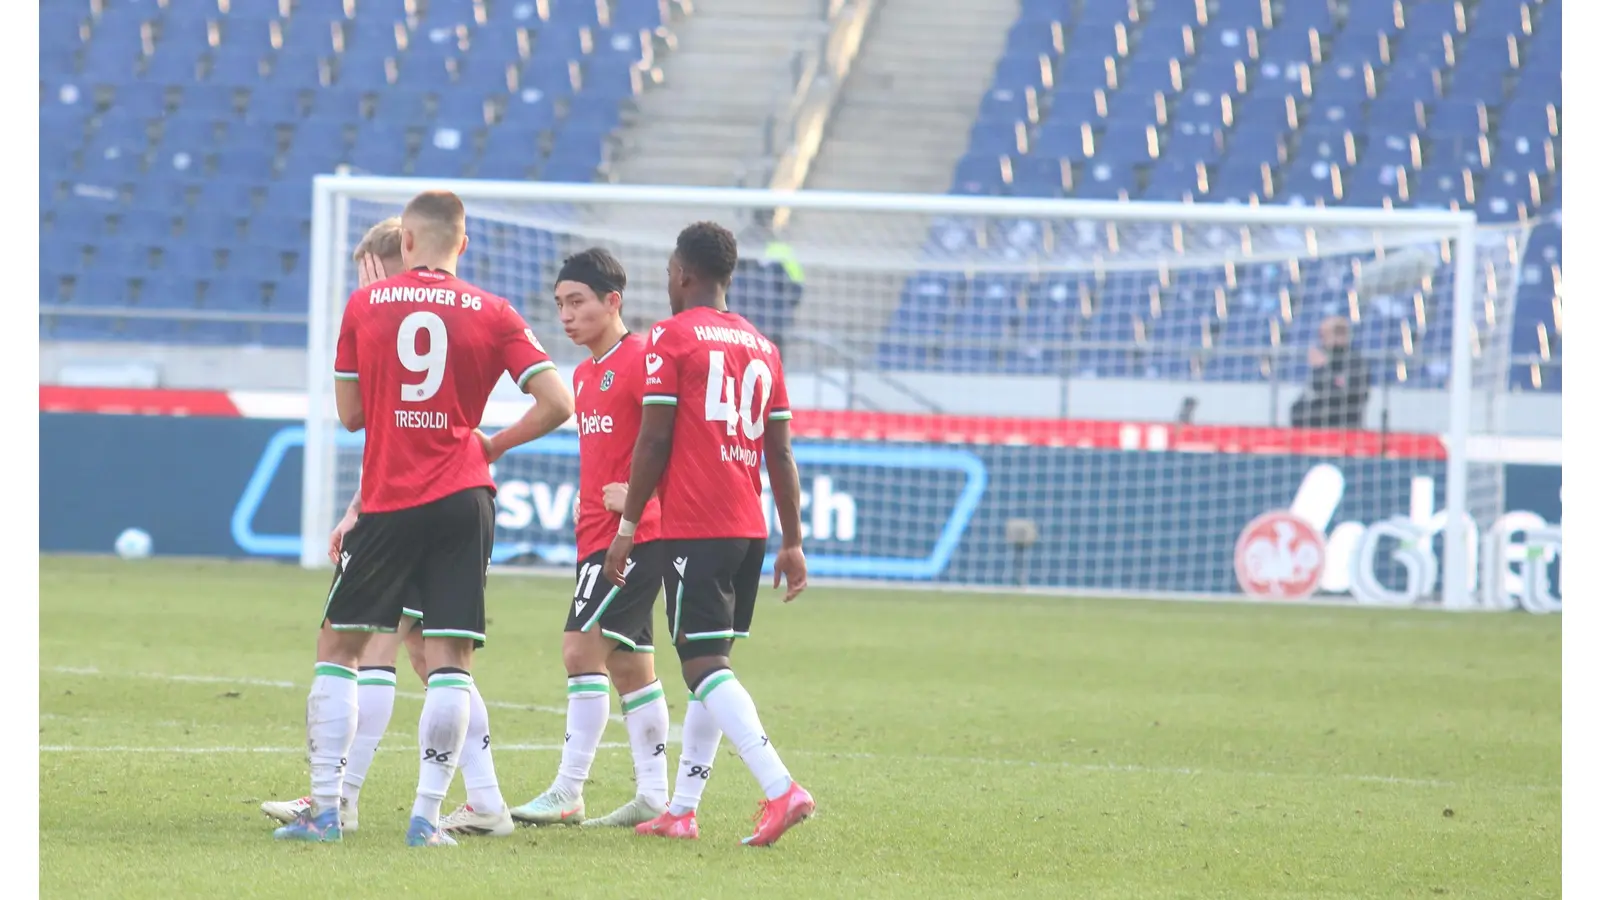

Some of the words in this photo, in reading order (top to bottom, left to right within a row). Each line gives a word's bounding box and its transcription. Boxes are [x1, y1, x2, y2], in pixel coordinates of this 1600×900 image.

[369, 286, 456, 306] HANNOVER
[461, 293, 482, 311] 96
[693, 325, 758, 351] HANNOVER
[396, 311, 448, 402] 9
[705, 350, 773, 441] 40
[394, 410, 448, 429] TRESOLDI
[574, 562, 602, 600] 11
[422, 748, 452, 762] 96
[687, 765, 711, 779] 96
